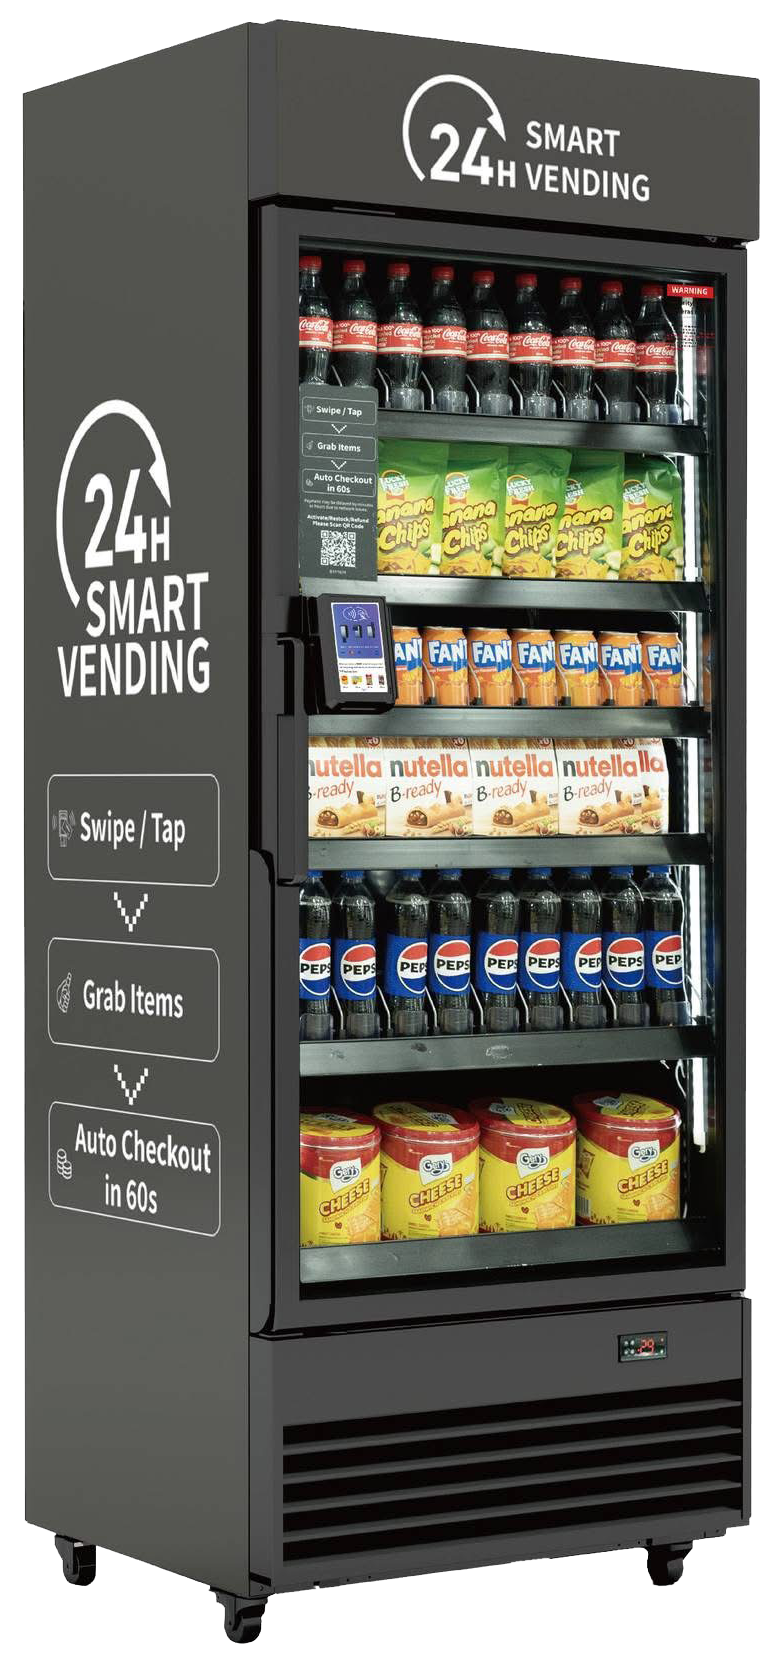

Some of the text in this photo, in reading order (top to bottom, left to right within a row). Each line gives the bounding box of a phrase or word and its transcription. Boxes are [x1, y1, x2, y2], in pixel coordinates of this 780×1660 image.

[430, 122, 516, 188] 24H
[525, 120, 620, 157] SMART
[525, 162, 650, 202] VENDING
[671, 286, 708, 295] WARNING
[316, 405, 362, 417] Swipe / Tap
[318, 442, 361, 452] Grab Items
[314, 473, 373, 484] Auto Checkout
[327, 484, 351, 493] in 60s
[84, 468, 170, 568] 24H
[379, 518, 431, 551] Chips
[443, 522, 488, 556] Chips
[505, 523, 551, 556] Chips
[555, 527, 605, 558] Chips
[628, 525, 671, 558] Chips
[86, 572, 209, 638] SMART
[57, 636, 210, 698] VENDING
[390, 753, 468, 778] nutella
[476, 754, 553, 778] nutella
[563, 754, 638, 777] nutella
[390, 779, 442, 803] B-ready
[476, 779, 528, 802] B-ready
[564, 778, 612, 802] B-ready
[80, 809, 185, 851] Swipe / Tap
[437, 959, 470, 971] PEPS
[608, 955, 643, 967] PEPS
[83, 979, 183, 1019] Grab Items
[75, 1123, 211, 1174] Auto Checkout
[409, 1174, 462, 1208] CHEESE
[506, 1167, 559, 1200] CHEESE
[618, 1159, 668, 1193] CHEESE
[105, 1173, 157, 1214] in 60s
[319, 1178, 370, 1217] CHEESE
